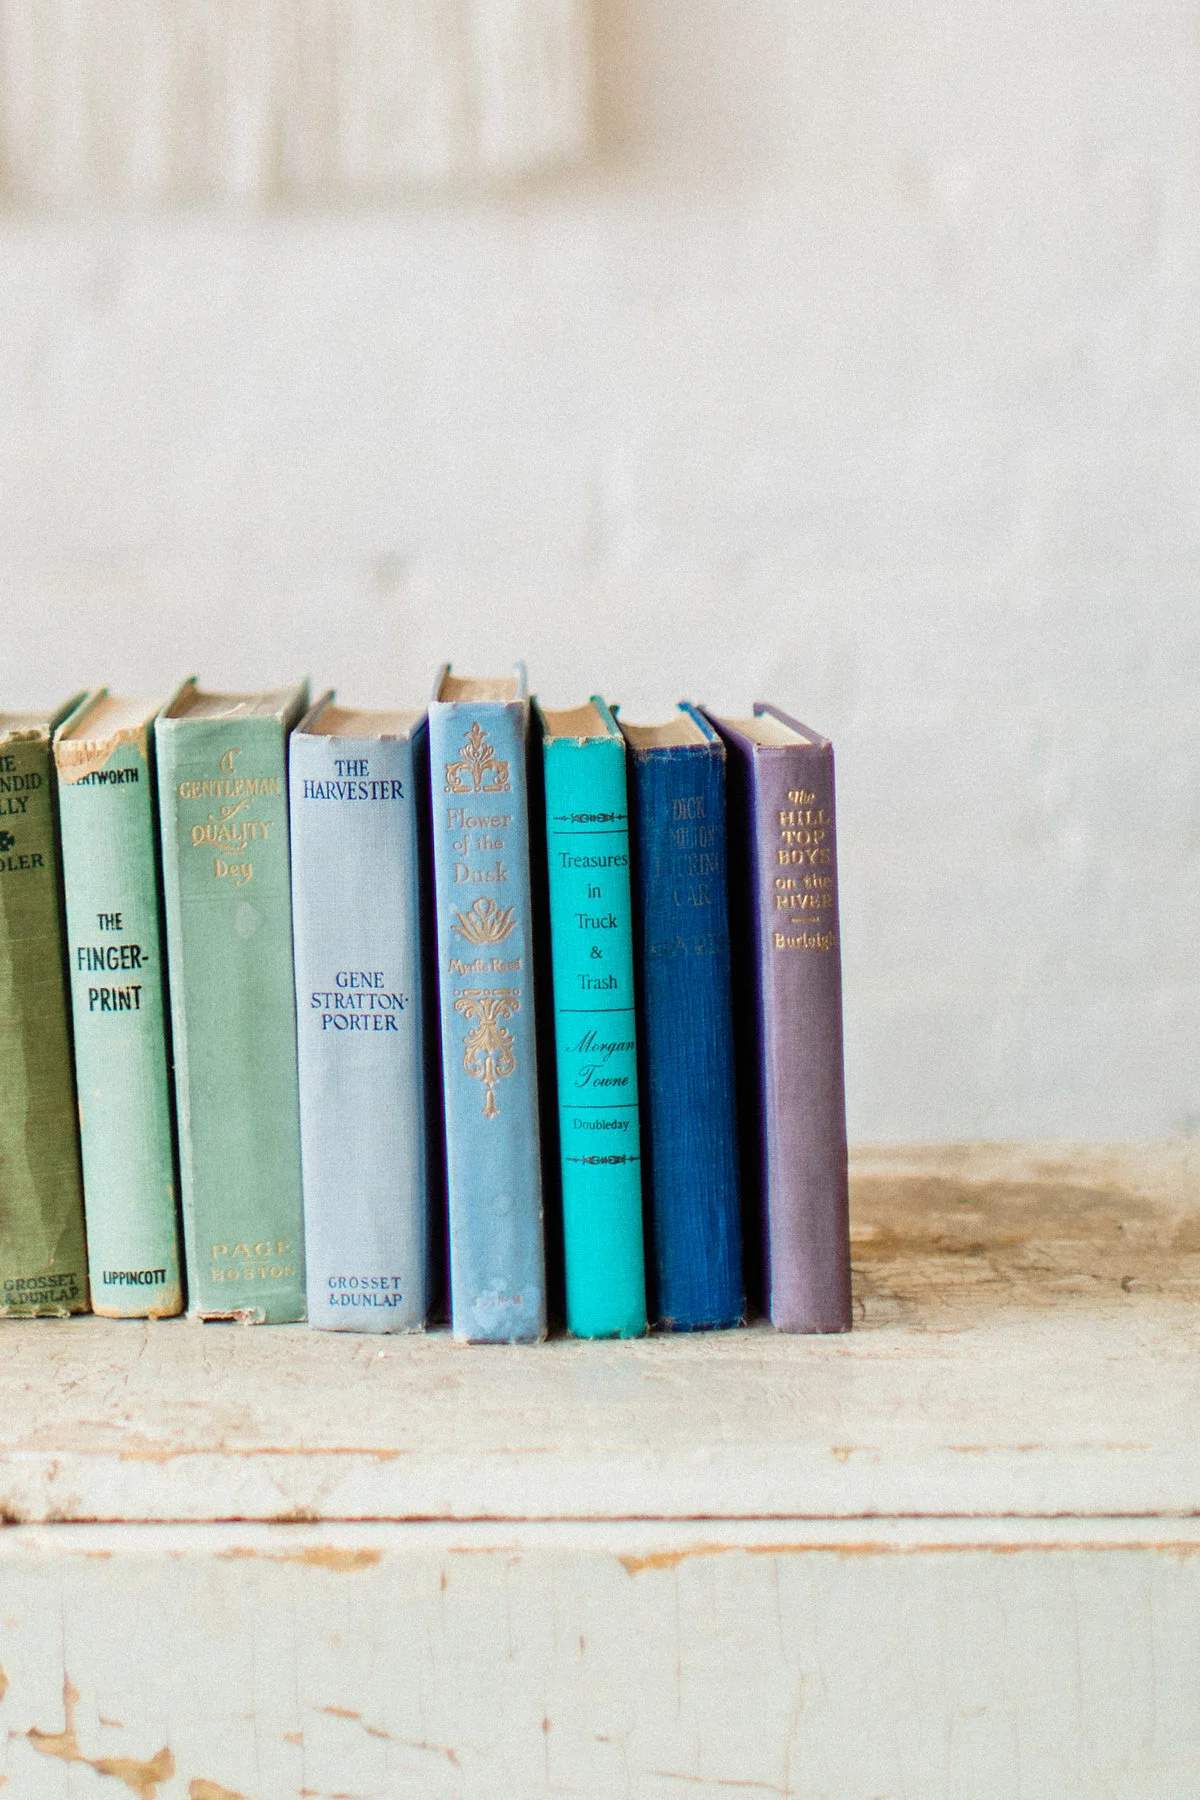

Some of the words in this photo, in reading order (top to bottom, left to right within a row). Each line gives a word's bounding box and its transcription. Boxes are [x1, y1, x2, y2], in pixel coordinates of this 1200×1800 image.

[334, 758, 370, 778] THE
[178, 776, 280, 800] GENTLEMAN
[302, 778, 405, 801] HARVESTER
[787, 789, 816, 806] The
[207, 796, 254, 824] of
[671, 795, 707, 821] DICK
[778, 808, 831, 827] HILL
[446, 807, 513, 830] Flower
[190, 820, 274, 850] QUALITY
[781, 829, 826, 846] TOP
[451, 834, 471, 858] of
[476, 834, 504, 851] the
[557, 851, 629, 869] Treasures
[777, 847, 831, 866] BOYS
[213, 858, 254, 887] Dey
[453, 861, 509, 885] Dusk
[774, 876, 795, 890] on
[802, 872, 833, 890] the
[587, 883, 602, 899] in
[775, 893, 834, 911] RIVER
[96, 912, 123, 931] THE
[574, 913, 619, 930] Truck
[77, 944, 149, 971] FINGER-
[589, 945, 604, 960] &
[335, 971, 386, 989] GENE
[577, 973, 619, 990] Trash
[88, 985, 142, 1012] PRINT
[321, 1012, 399, 1032] PORTER
[565, 1029, 636, 1063] Morgan
[573, 1063, 630, 1089] Towne
[572, 1118, 630, 1133] Doubleday
[210, 1240, 294, 1259] PAGE
[3, 1272, 77, 1292] GROSSET
[102, 1268, 167, 1286] LIPPINCOTT
[210, 1264, 297, 1282] BOSTON
[327, 1276, 403, 1290] GROSSET
